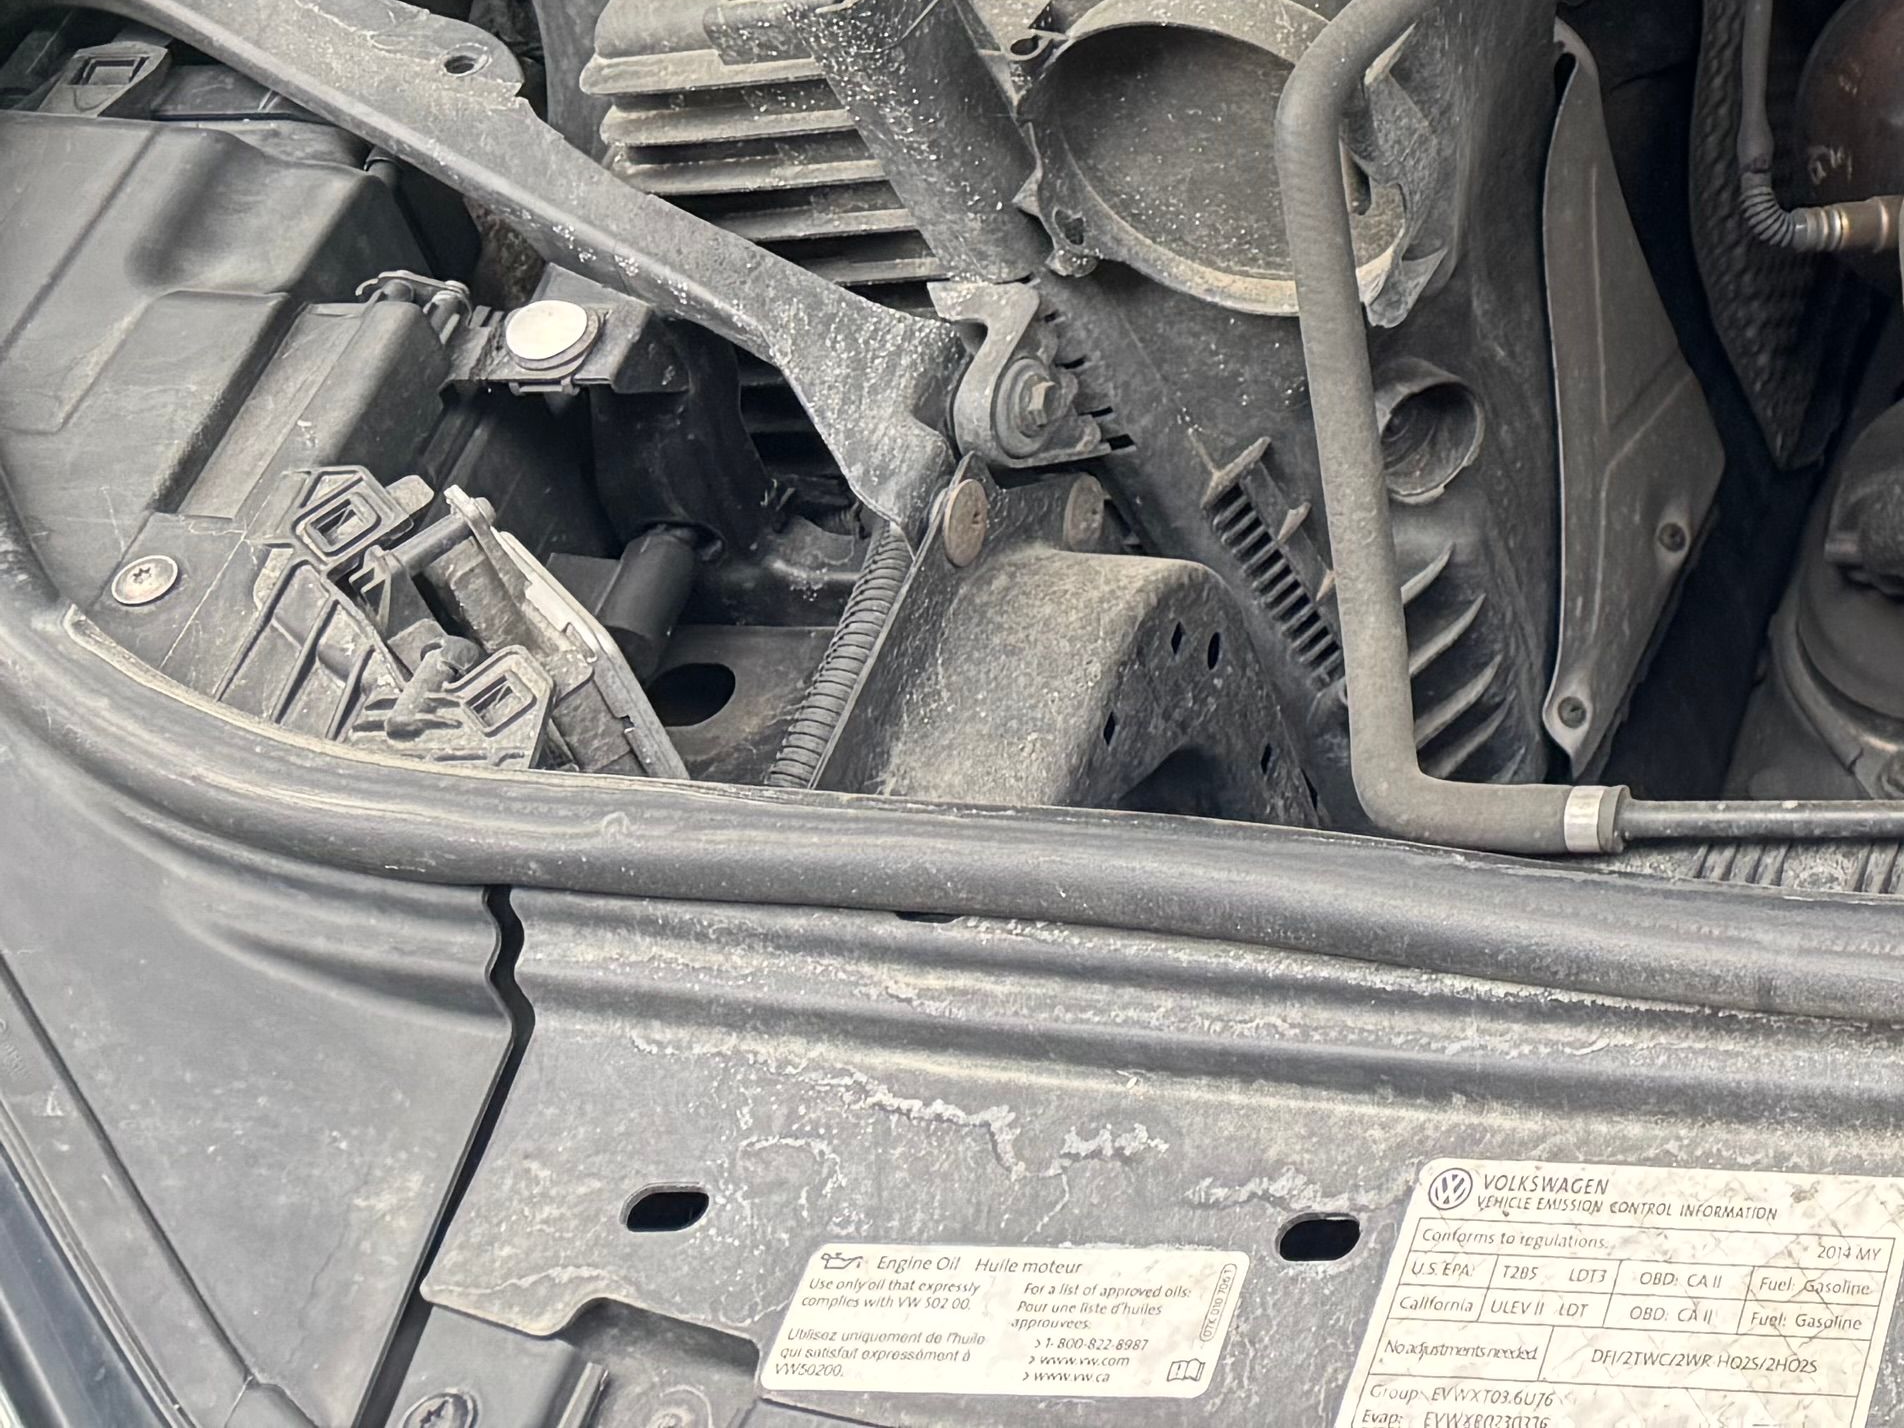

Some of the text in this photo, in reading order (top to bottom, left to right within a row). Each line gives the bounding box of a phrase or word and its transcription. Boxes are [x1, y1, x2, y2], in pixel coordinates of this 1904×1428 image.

[1483, 1174, 1609, 1195] VOLKSWAGEN
[1477, 1196, 1778, 1221] VEHICLE EMISSION CONTROL INFORMATION
[1423, 1227, 1494, 1248] Conforms
[1501, 1232, 1515, 1244] to
[1817, 1245, 1881, 1261] 2014 MY
[877, 1256, 1083, 1274] Engine Oil Huile moteur
[1569, 1268, 1607, 1284] LDT3
[1687, 1273, 1709, 1288] CA
[809, 1278, 981, 1296] Use only oil that expressly
[1024, 1282, 1045, 1295] For
[1048, 1285, 1055, 1295] a
[1059, 1283, 1079, 1295] list
[1083, 1283, 1098, 1296] of
[1100, 1284, 1161, 1299] approved
[1803, 1279, 1871, 1296] Gasoline
[801, 1295, 859, 1310] complies
[864, 1295, 894, 1308] with
[899, 1297, 922, 1308] VW
[926, 1297, 948, 1309] 502
[1016, 1300, 1048, 1313] Pour
[1051, 1303, 1076, 1313] une
[1080, 1301, 1107, 1314] liste
[1400, 1296, 1473, 1312] California
[1491, 1299, 1531, 1315] ULEV
[1559, 1302, 1588, 1318] LDT
[1677, 1308, 1697, 1322] CA
[1795, 1314, 1862, 1330] Gasoline
[1039, 1355, 1130, 1367] www.vw.com
[1034, 1371, 1110, 1384] www.vw.ca
